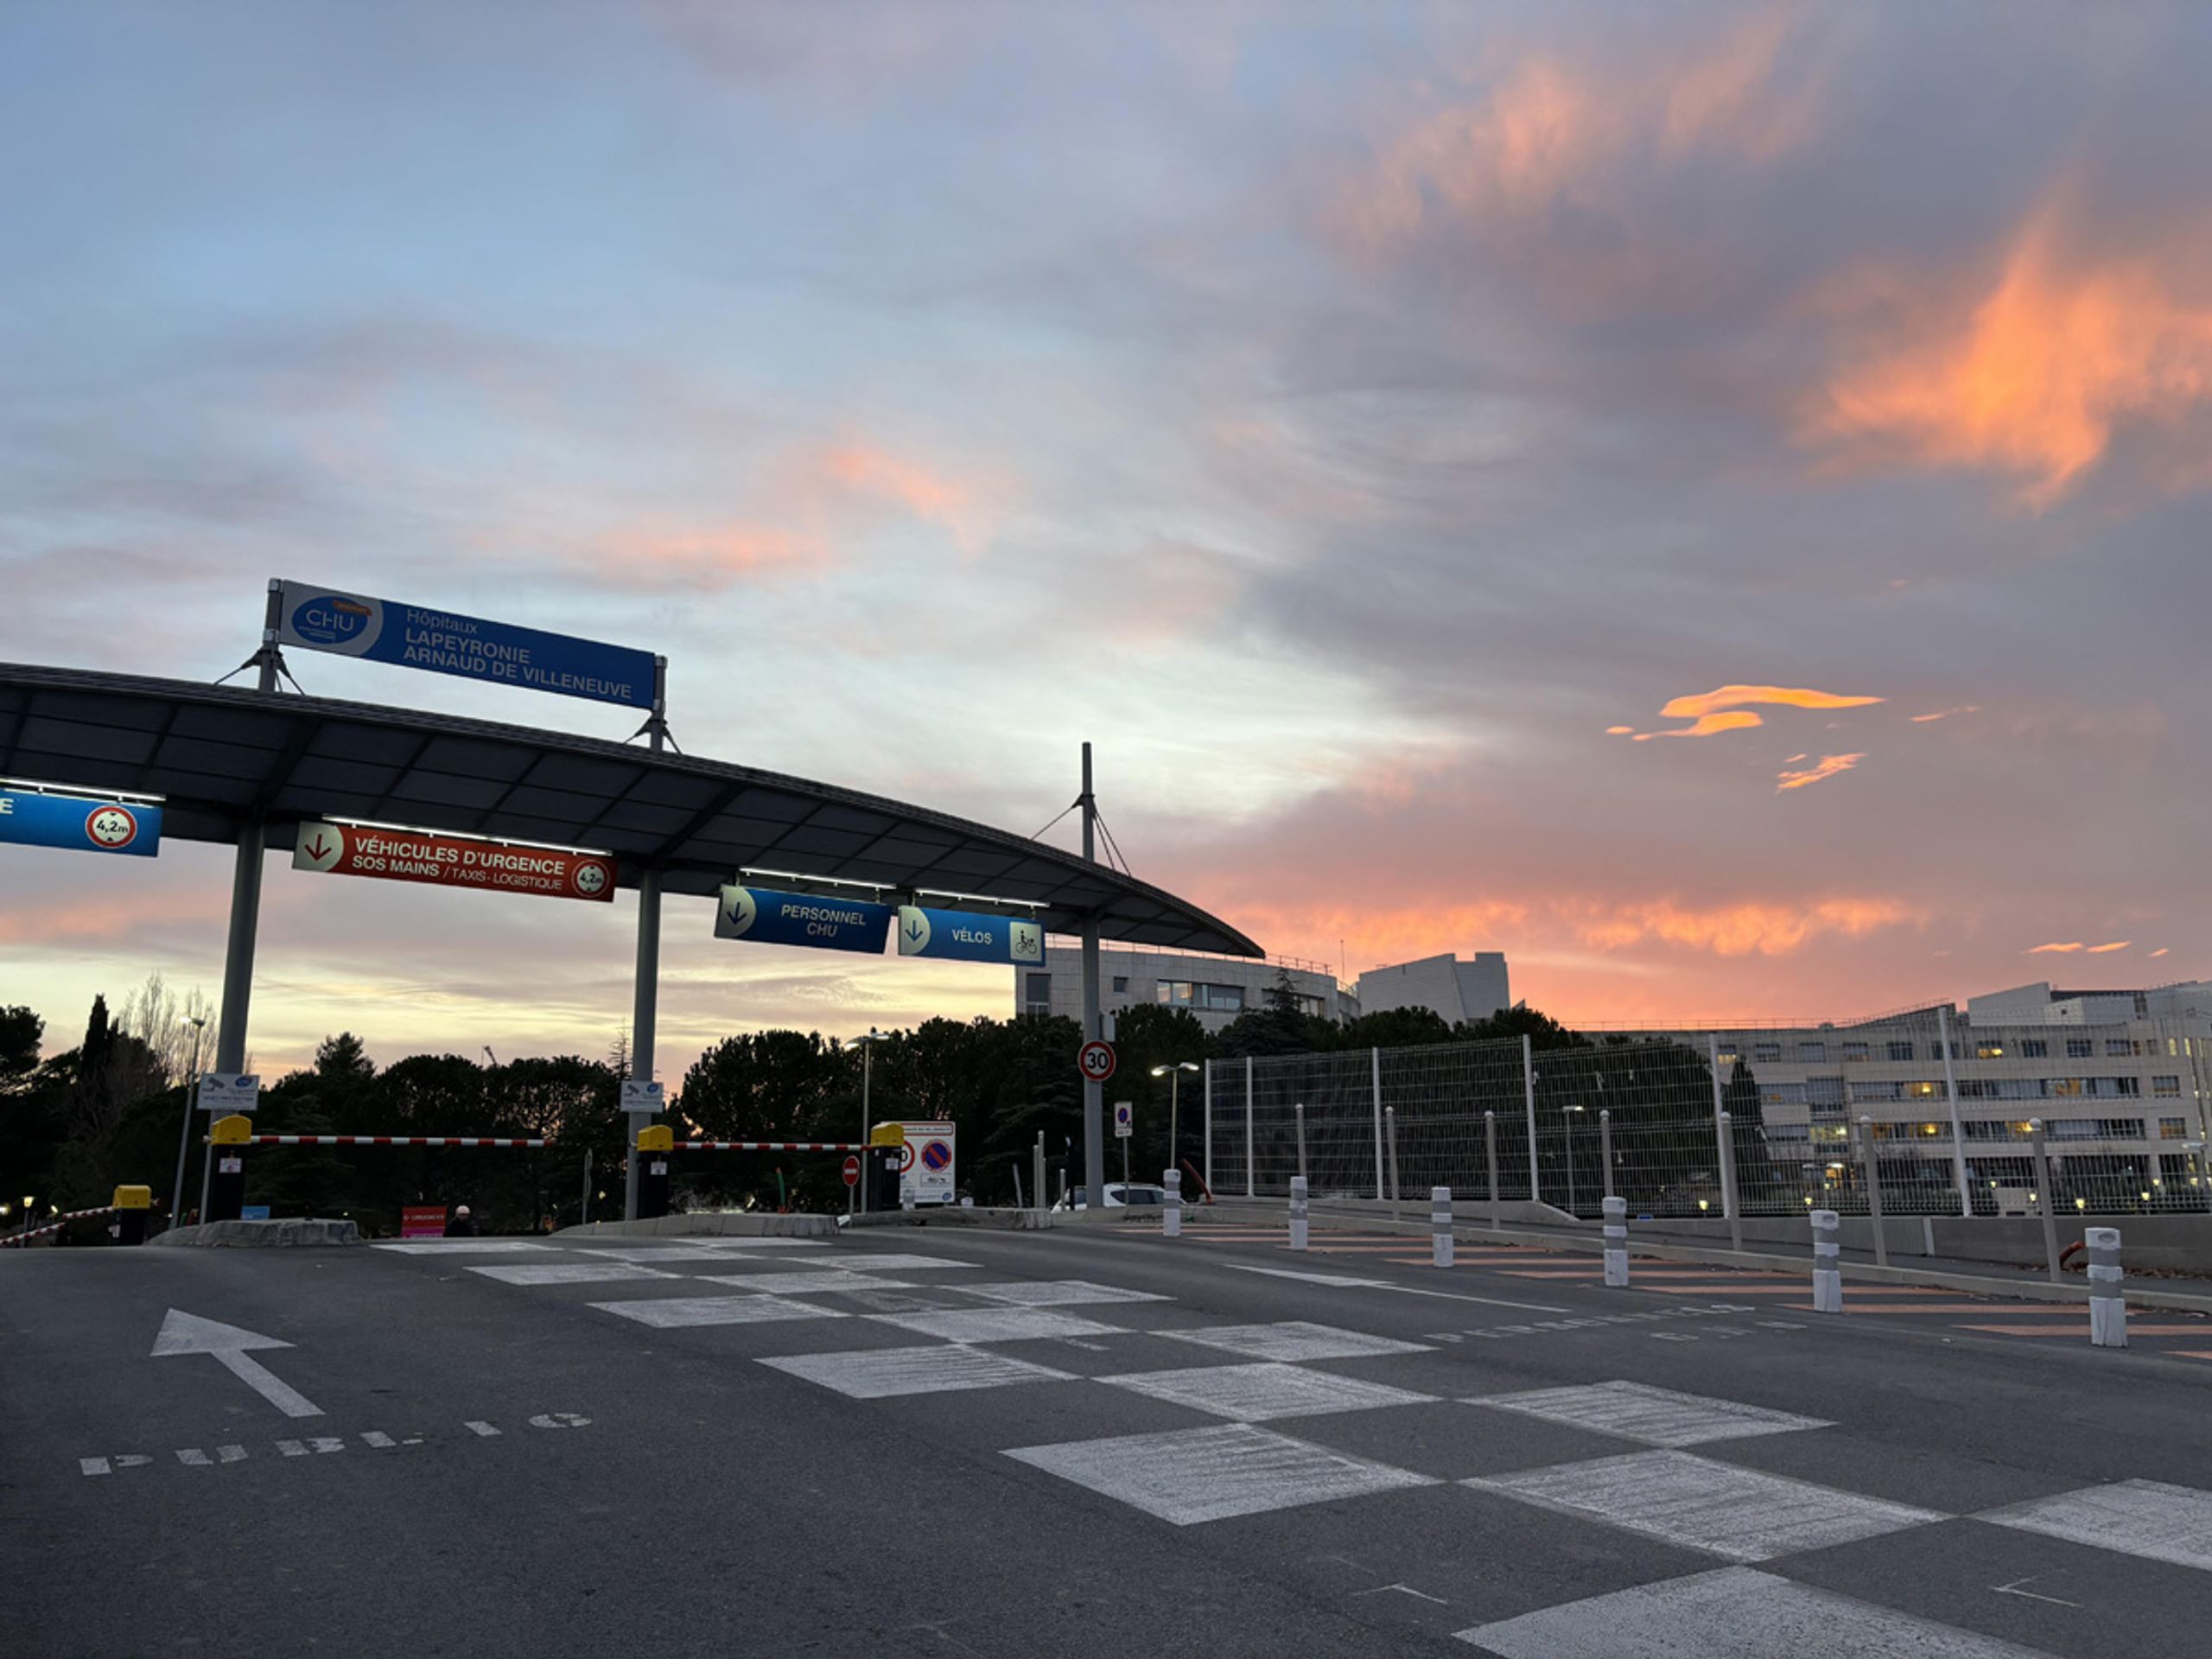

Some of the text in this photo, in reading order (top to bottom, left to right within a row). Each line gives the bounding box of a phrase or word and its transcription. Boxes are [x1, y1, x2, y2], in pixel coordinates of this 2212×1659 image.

[306, 609, 354, 632] CHU
[407, 608, 478, 634] Hôpitaux
[405, 626, 531, 664] LAPEYRONIE
[403, 645, 632, 699] ARNAUD DE VILLENEUVE
[355, 835, 565, 875] VÉHICULES D'URGENCE
[352, 855, 386, 872] SOS
[390, 859, 440, 877] MAINS
[452, 868, 486, 882] TAXIS
[493, 872, 562, 891] LOGISTIQUE
[781, 904, 867, 926] PERSONNEL
[806, 922, 838, 938] CHU
[951, 926, 993, 945] VÉLOS
[1087, 1052, 1108, 1069] 30
